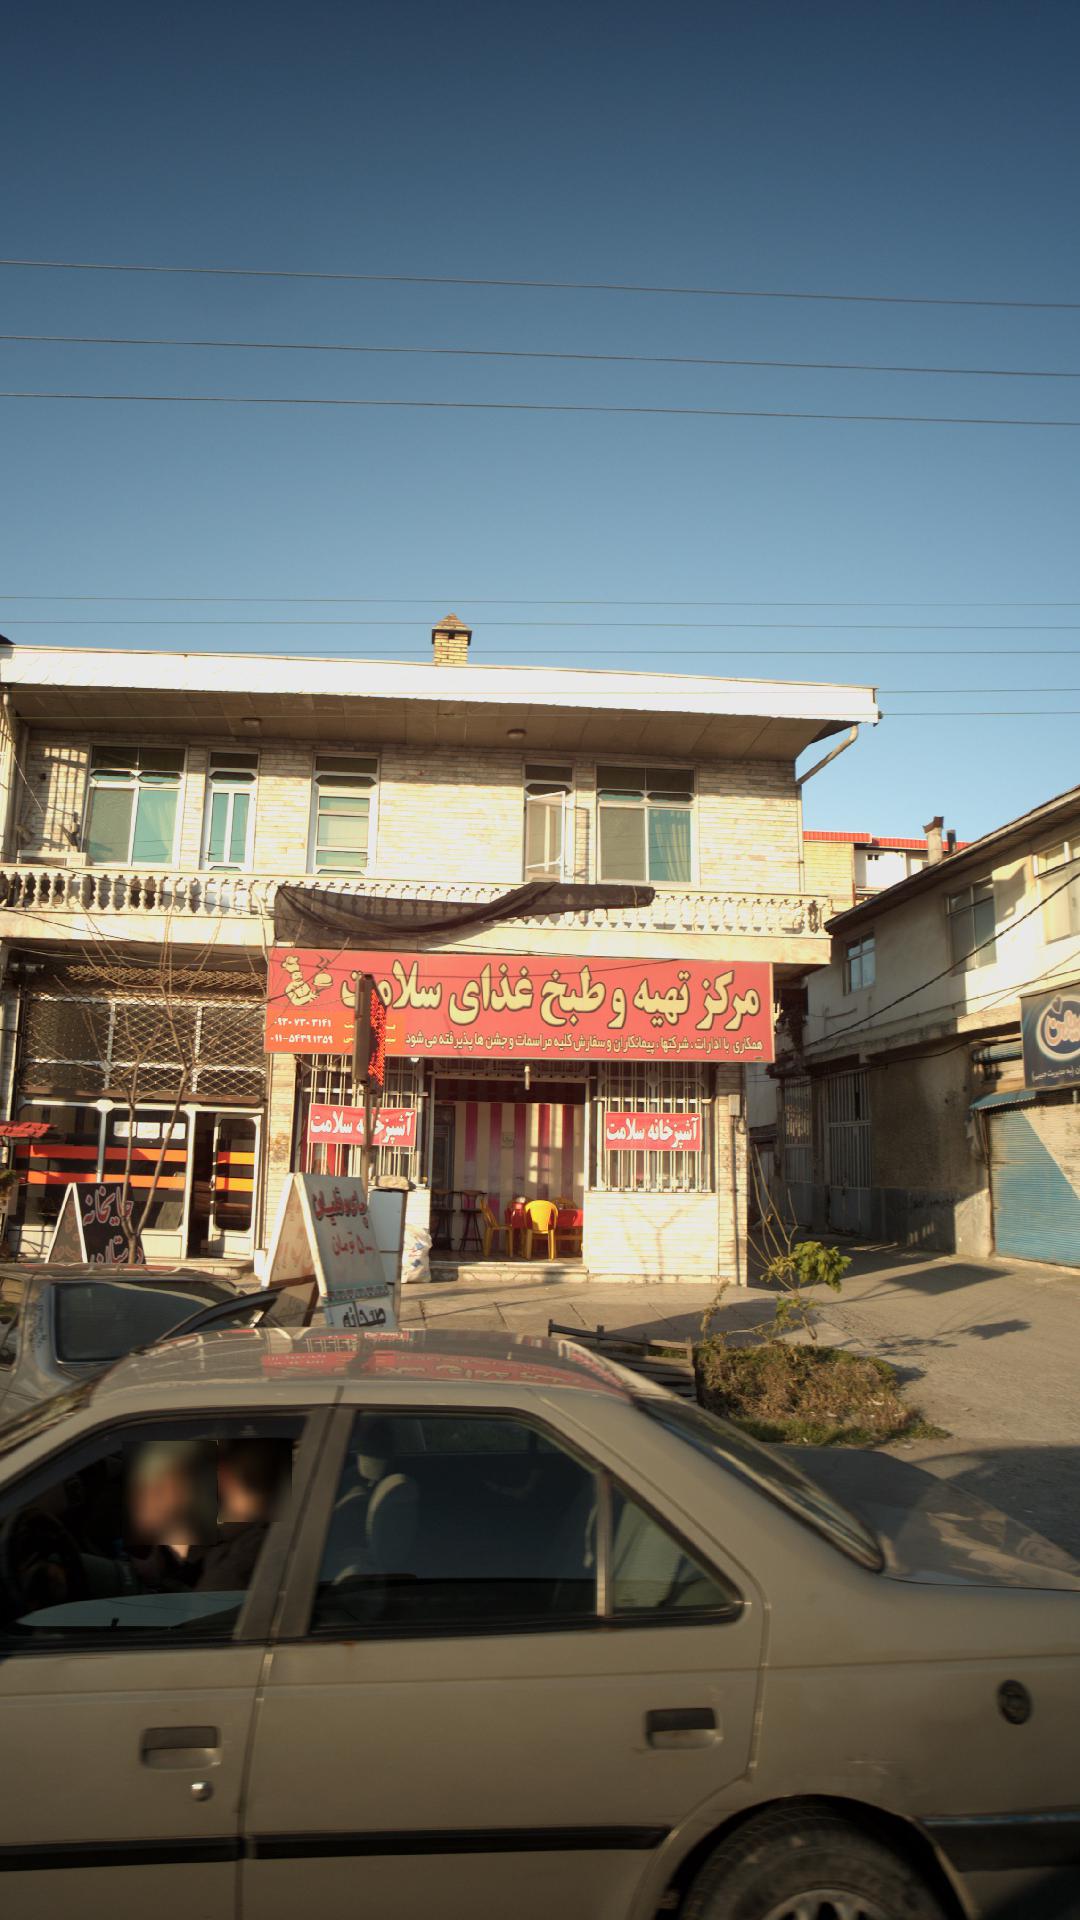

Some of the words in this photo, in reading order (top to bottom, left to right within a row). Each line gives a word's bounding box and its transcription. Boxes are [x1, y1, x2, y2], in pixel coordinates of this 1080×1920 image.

[341, 959, 443, 1009] سلامت
[448, 962, 534, 1026] غذای
[540, 965, 606, 1027] طبخ
[607, 988, 627, 1029] و
[632, 970, 691, 1027] تهیه
[695, 969, 761, 1031] مرکز
[438, 1031, 473, 1051] پذیرفته
[515, 1033, 553, 1051] مراسمات
[553, 1033, 573, 1051] کلیه
[613, 1035, 655, 1054] پیمانکاران
[723, 1038, 730, 1053] با
[732, 1037, 763, 1054] همکاری
[310, 1110, 353, 1134] سلامت
[356, 1111, 415, 1145] آشپزخاه
[606, 1117, 645, 1141] سلامت
[648, 1117, 699, 1149] آشپزخانه
